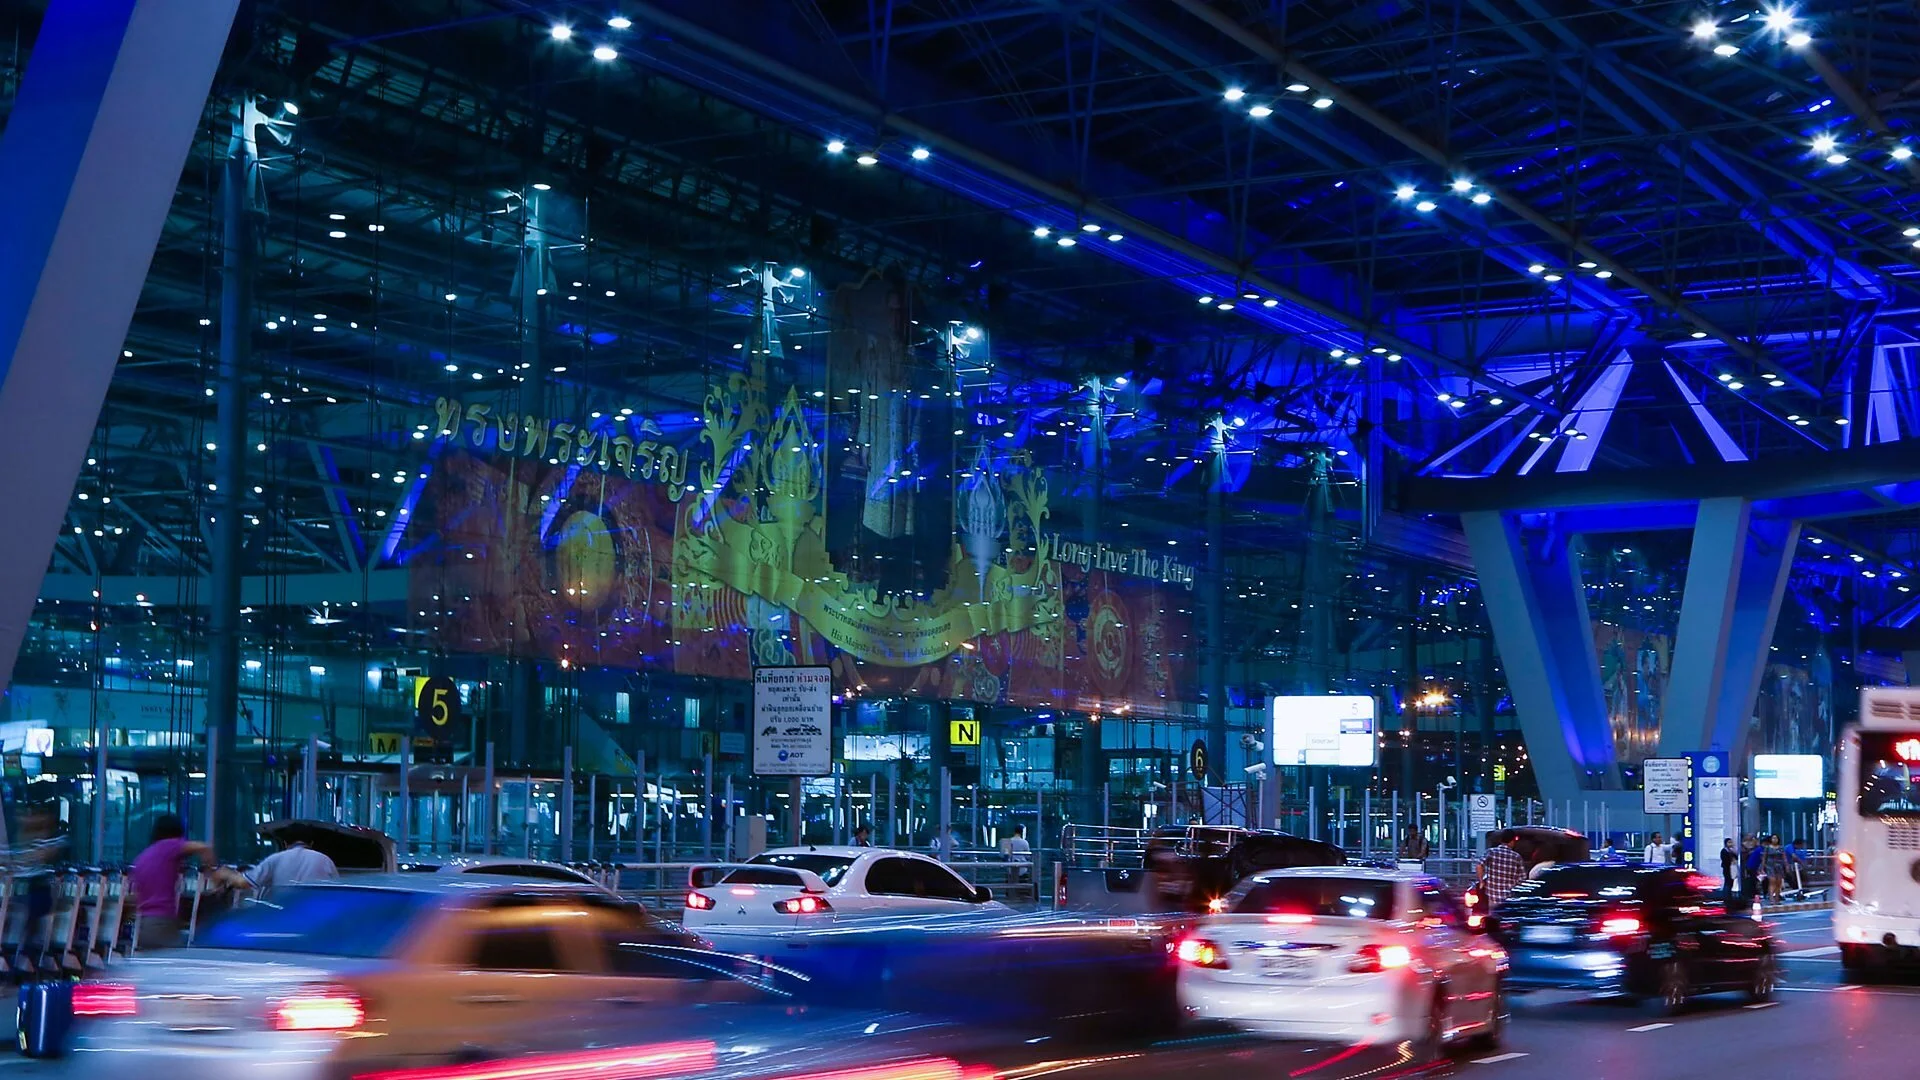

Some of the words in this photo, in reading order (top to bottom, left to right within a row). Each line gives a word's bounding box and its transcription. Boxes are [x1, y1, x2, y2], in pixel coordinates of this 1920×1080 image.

[435, 396, 689, 502] ทรงพระเจริญ
[1051, 532, 1092, 573] Long
[1095, 541, 1128, 573] Live
[1131, 548, 1160, 579] The
[1162, 554, 1196, 591] King
[830, 628, 843, 641] His
[431, 688, 449, 726] 5
[958, 723, 974, 742] N
[377, 737, 397, 754] M
[1195, 748, 1204, 771] 6
